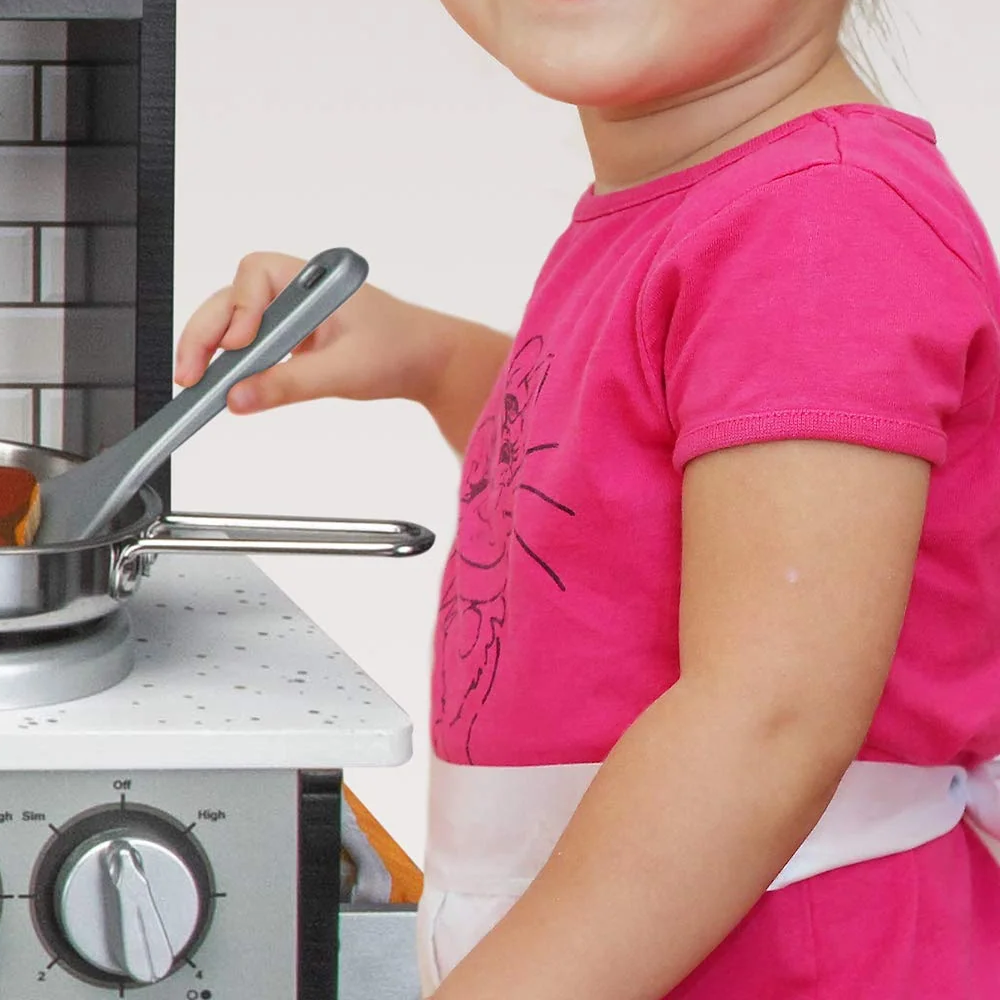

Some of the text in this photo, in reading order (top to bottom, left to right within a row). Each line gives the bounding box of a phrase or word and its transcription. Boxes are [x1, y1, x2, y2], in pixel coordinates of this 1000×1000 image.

[112, 779, 132, 790] Off
[21, 810, 46, 822] Sim
[198, 808, 226, 822] High
[37, 971, 46, 982] 2
[195, 970, 204, 981] 4
